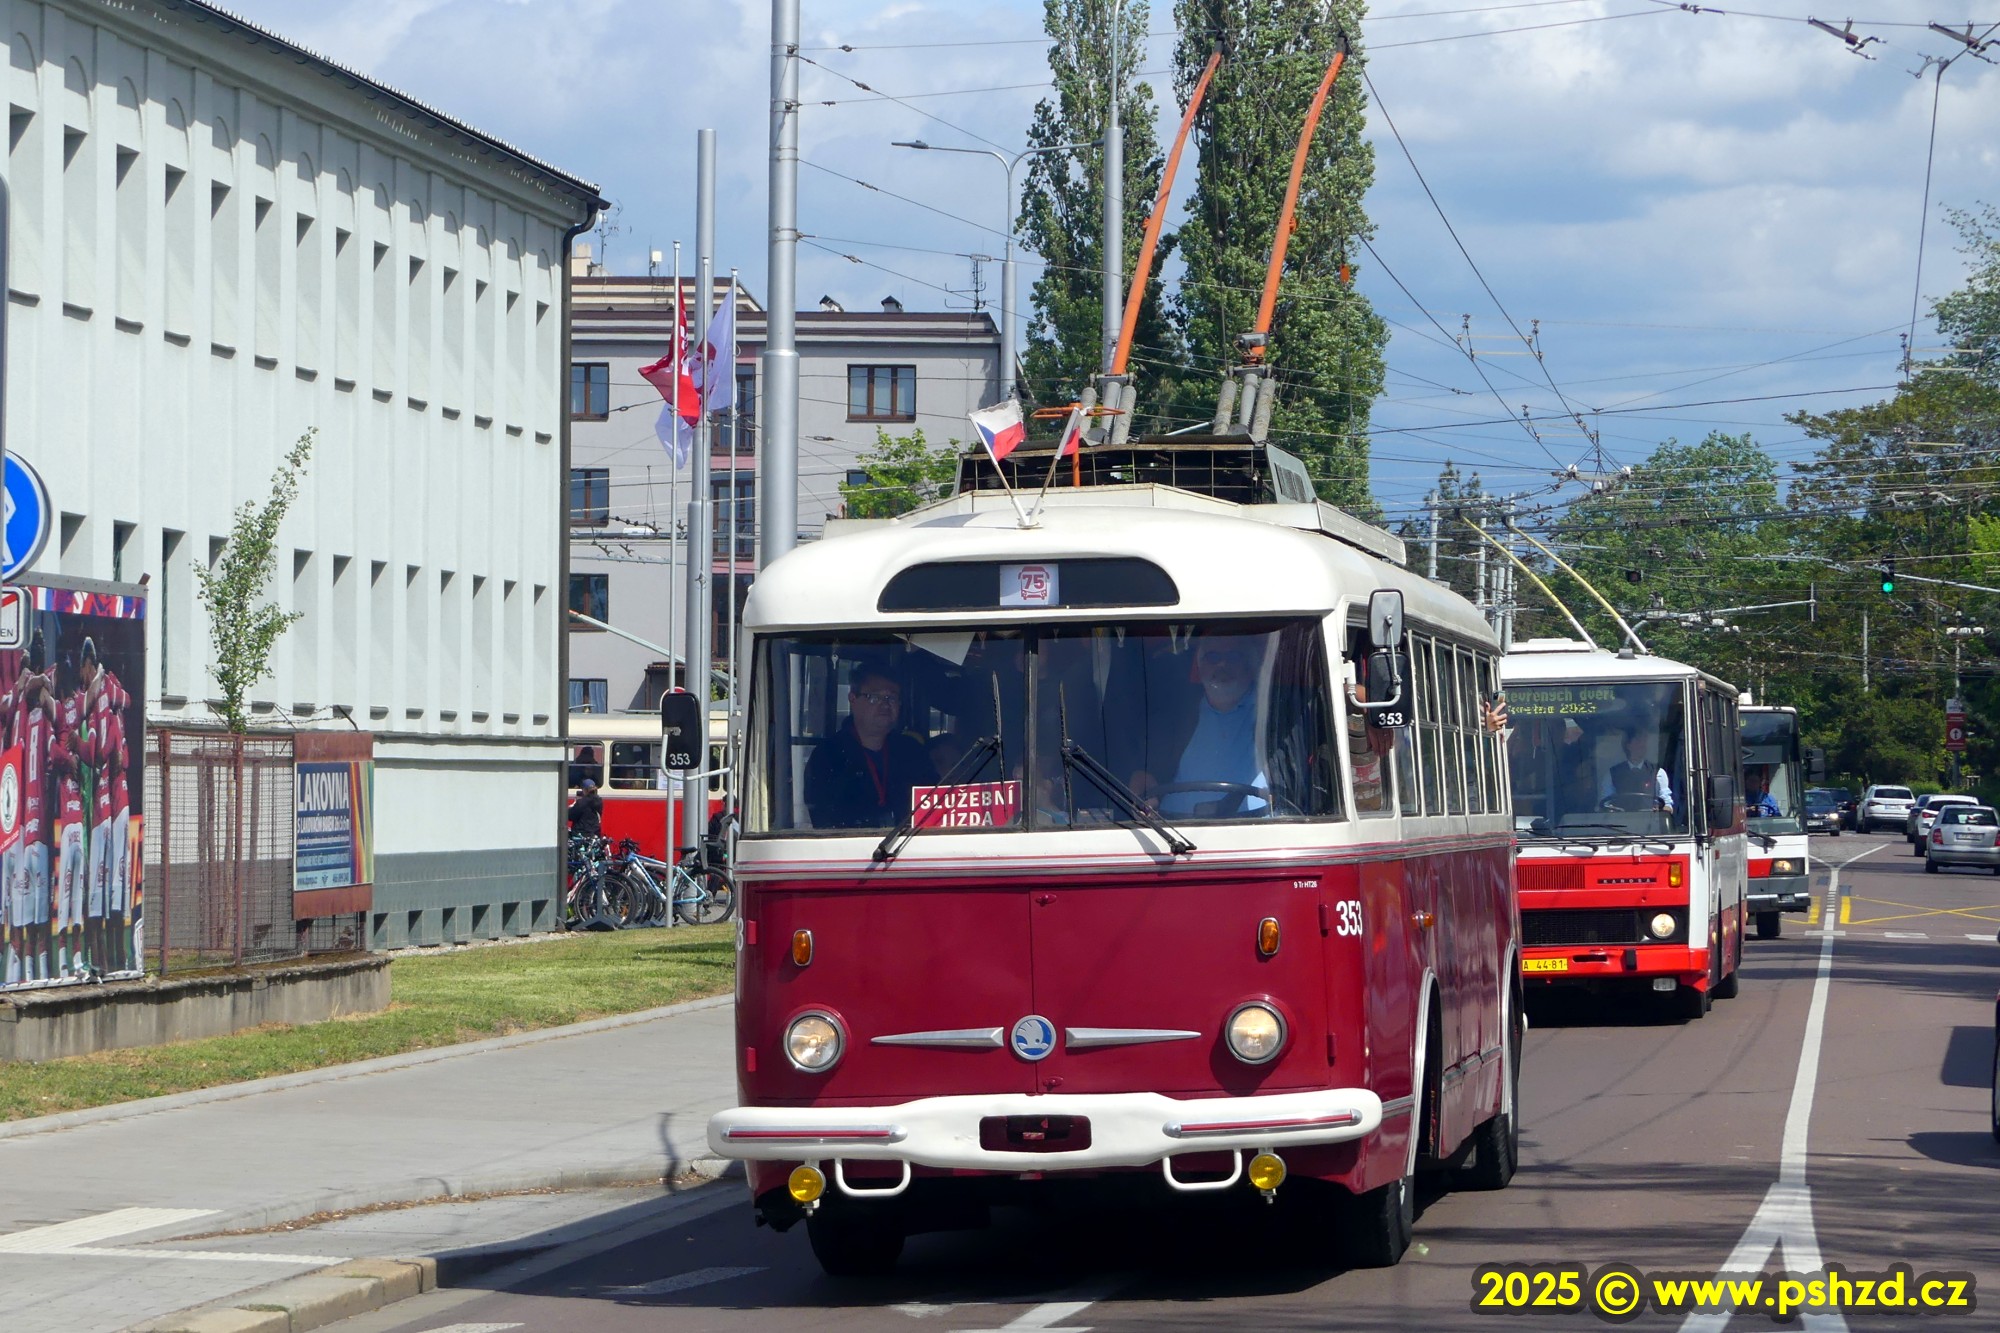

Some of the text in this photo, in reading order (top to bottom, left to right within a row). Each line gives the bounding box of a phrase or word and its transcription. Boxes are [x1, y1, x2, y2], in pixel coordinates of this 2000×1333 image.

[1022, 574, 1045, 590] 75
[1378, 712, 1403, 725] 353
[669, 752, 691, 766] 353
[297, 772, 350, 811] LAKOVNA
[920, 784, 1014, 810] SLUŽEBNÍ
[940, 809, 994, 828] JÍZDA
[1336, 900, 1363, 936] 353
